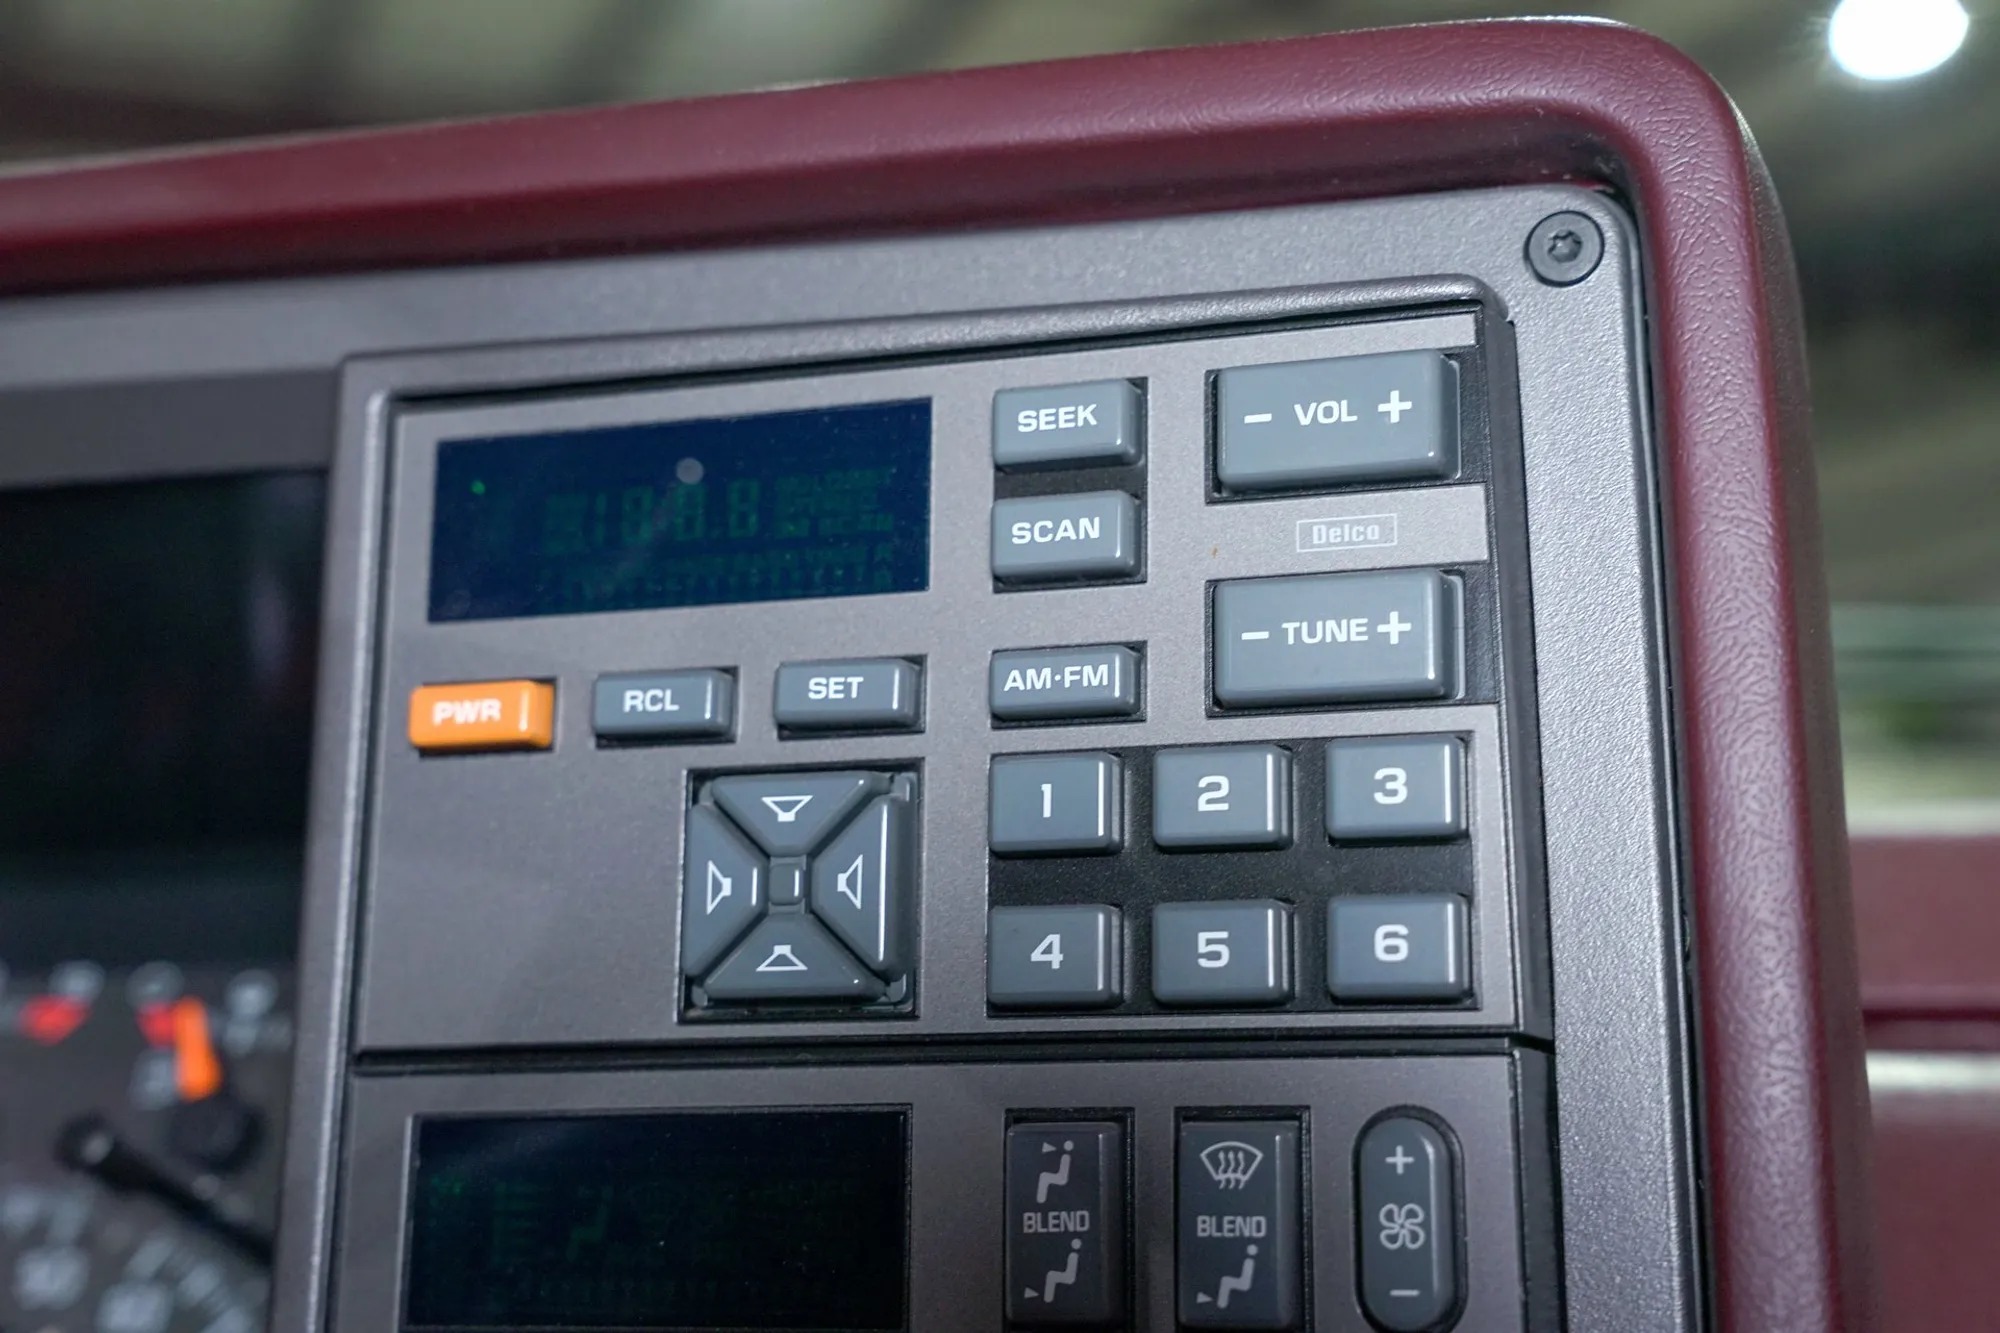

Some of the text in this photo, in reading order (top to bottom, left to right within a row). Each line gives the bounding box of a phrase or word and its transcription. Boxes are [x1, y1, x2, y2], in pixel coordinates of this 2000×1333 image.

[1017, 403, 1097, 433] SEEK
[1293, 400, 1358, 426] VOL
[1011, 516, 1100, 545] SCAN
[1311, 523, 1381, 545] Delco
[1281, 617, 1369, 645] TUNE
[624, 689, 680, 712] RCL
[808, 676, 864, 700] SET
[433, 699, 501, 724] PWR
[1198, 775, 1230, 812] 2
[1374, 767, 1408, 805] 3
[1041, 783, 1052, 818] 1
[1030, 933, 1064, 969] 4
[1197, 931, 1230, 968] 5
[1374, 924, 1409, 961] 6
[1023, 1210, 1090, 1233] BLEND
[1197, 1215, 1266, 1238] BLEND
